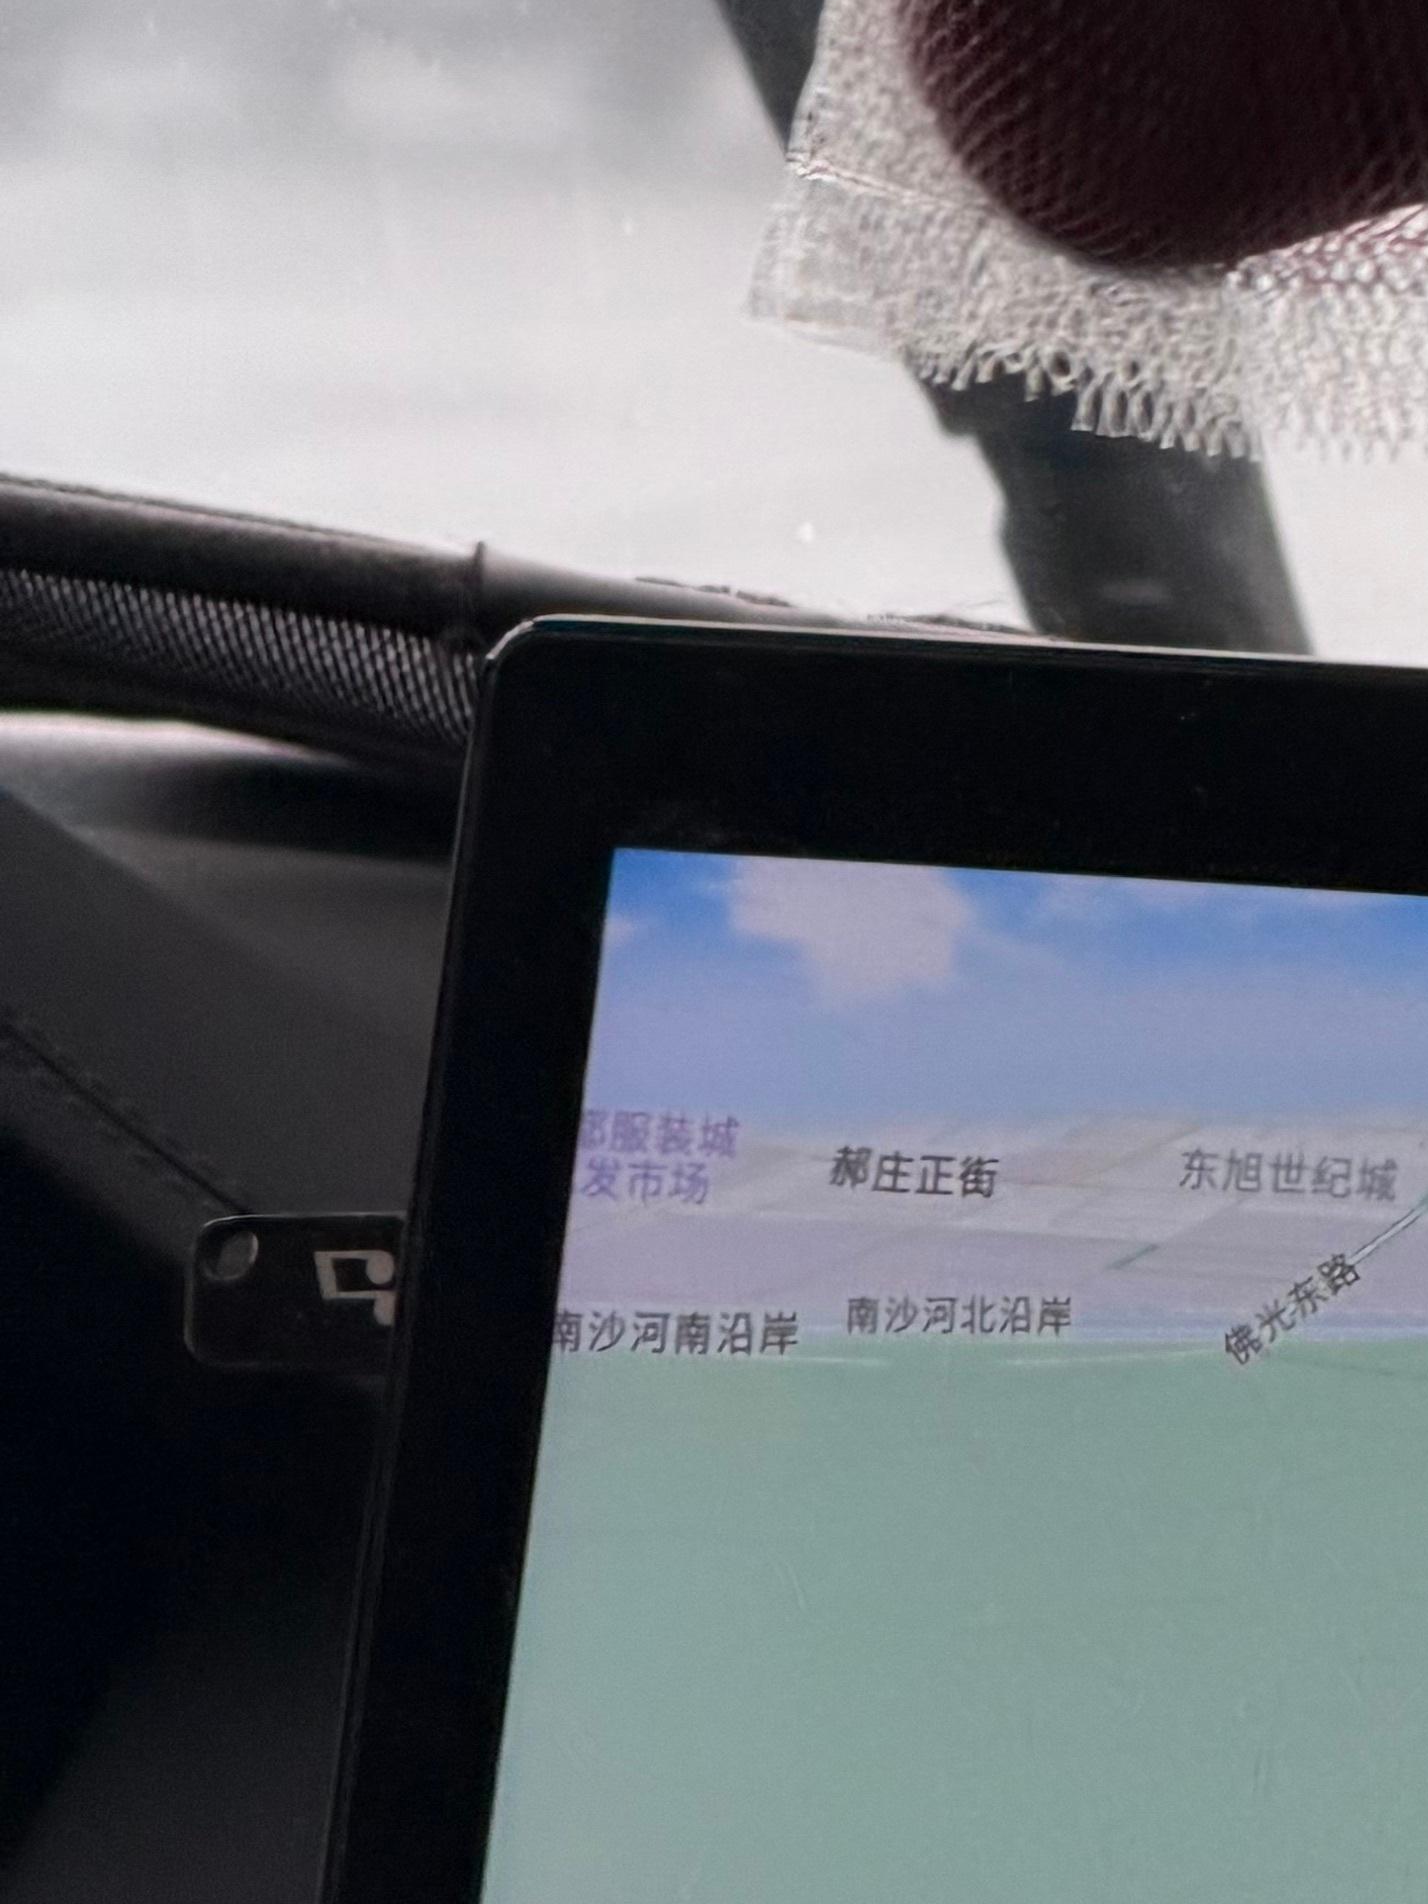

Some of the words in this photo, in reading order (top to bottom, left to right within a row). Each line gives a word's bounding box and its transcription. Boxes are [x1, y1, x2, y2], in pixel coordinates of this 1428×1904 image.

[829, 1145, 1000, 1199] 郝庄正街
[1178, 1148, 1398, 1202] 东旭世纪城
[552, 1308, 799, 1356] 南沙河南沿岸
[846, 1295, 1072, 1337] 南沙河北沿岸
[1224, 1253, 1361, 1365] 佛光东路
